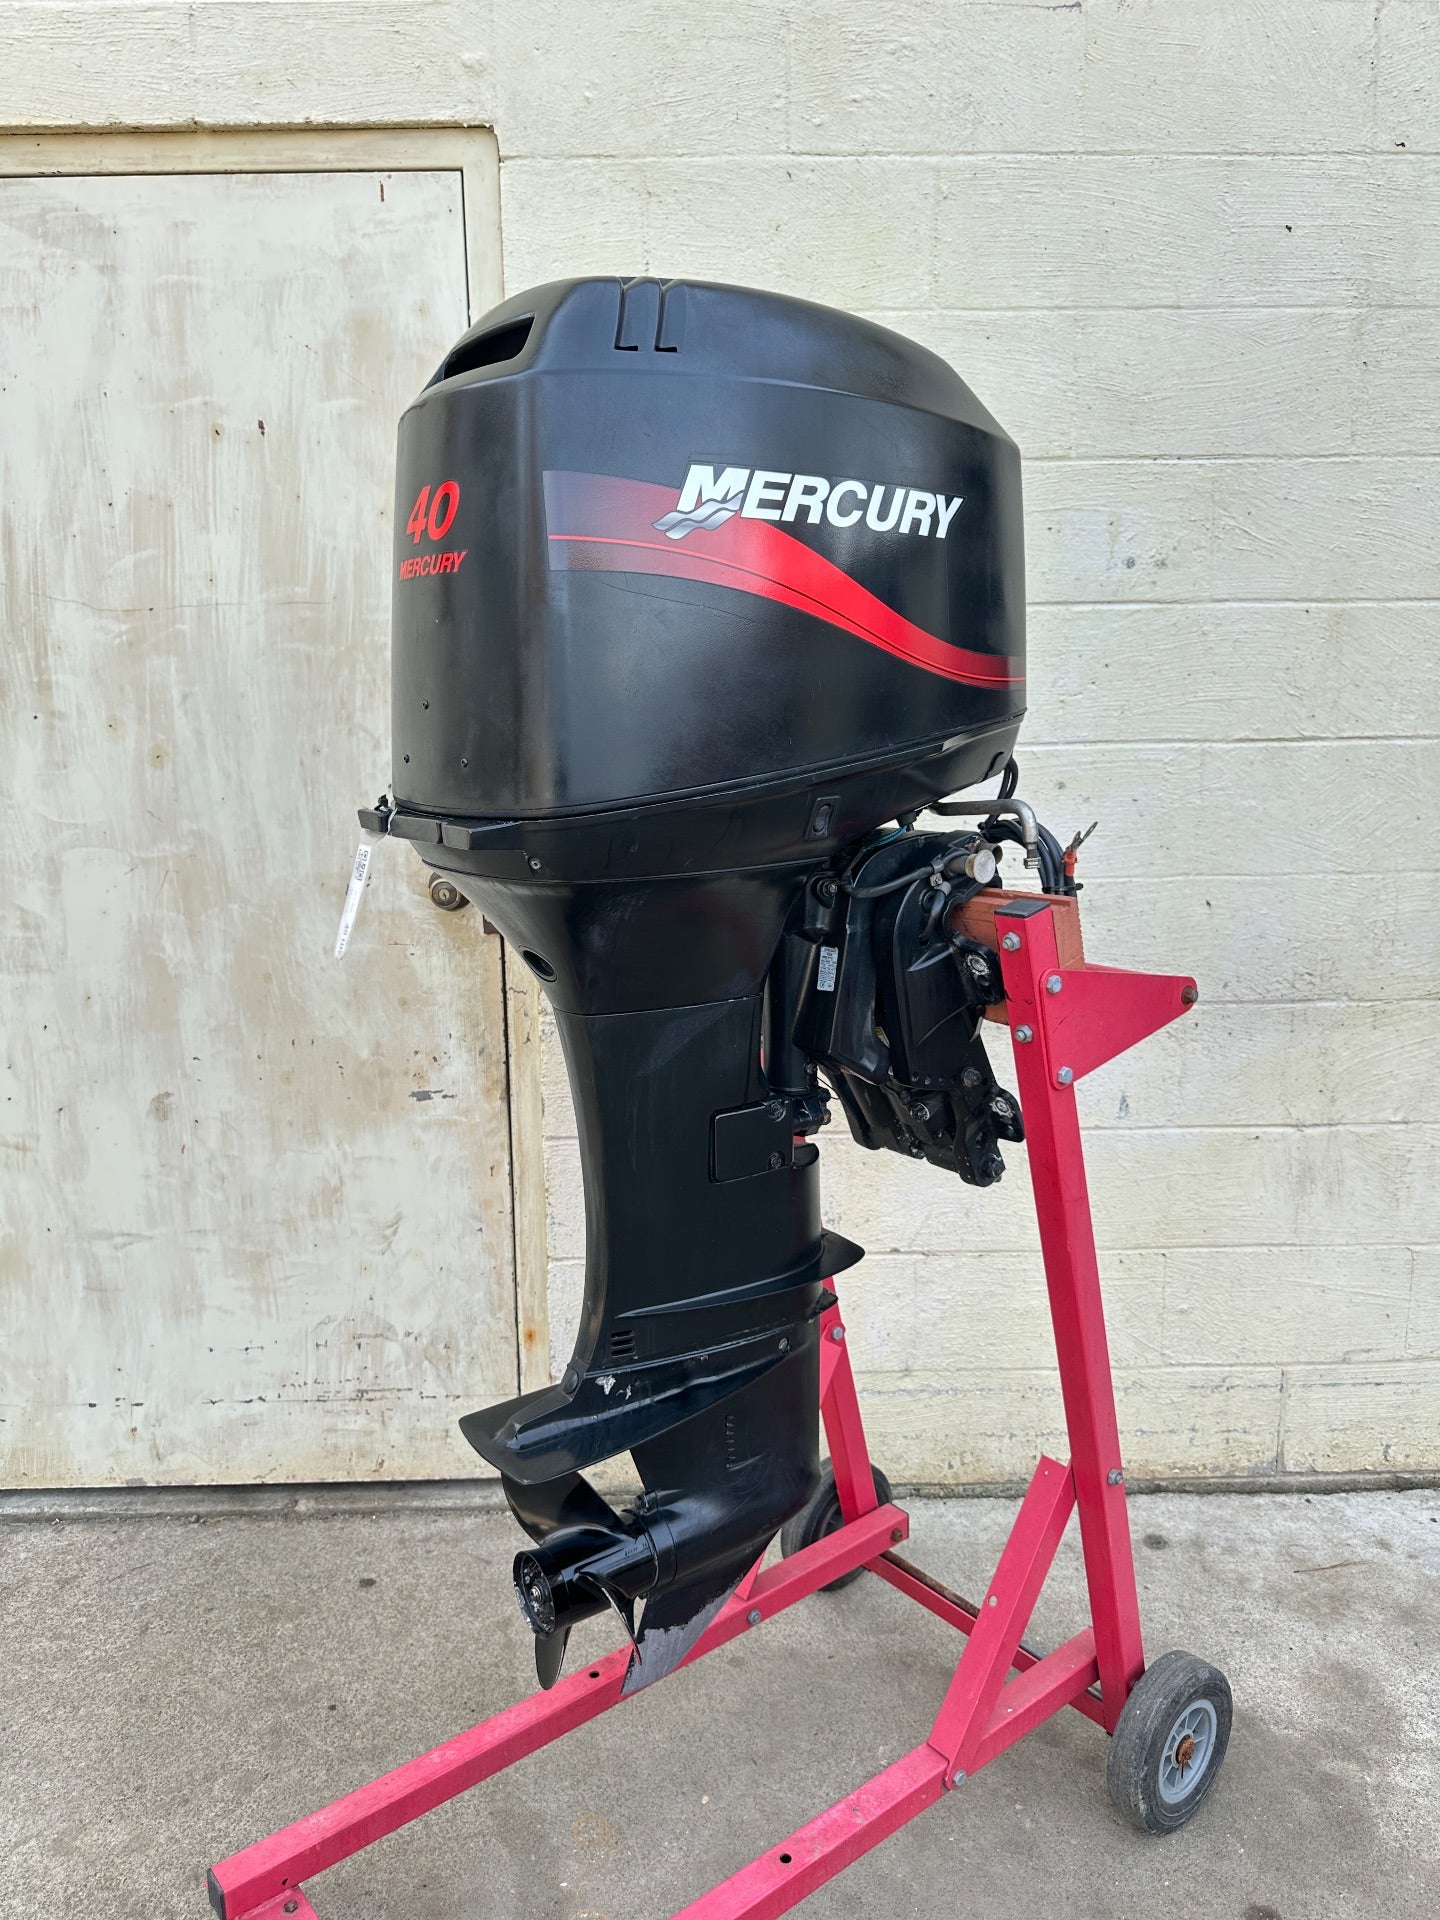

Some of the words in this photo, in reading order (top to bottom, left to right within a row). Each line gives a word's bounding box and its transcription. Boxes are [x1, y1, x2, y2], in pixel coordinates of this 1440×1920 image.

[406, 480, 460, 544] 40
[676, 464, 965, 539] MERCURY
[399, 551, 467, 580] MERCURY
